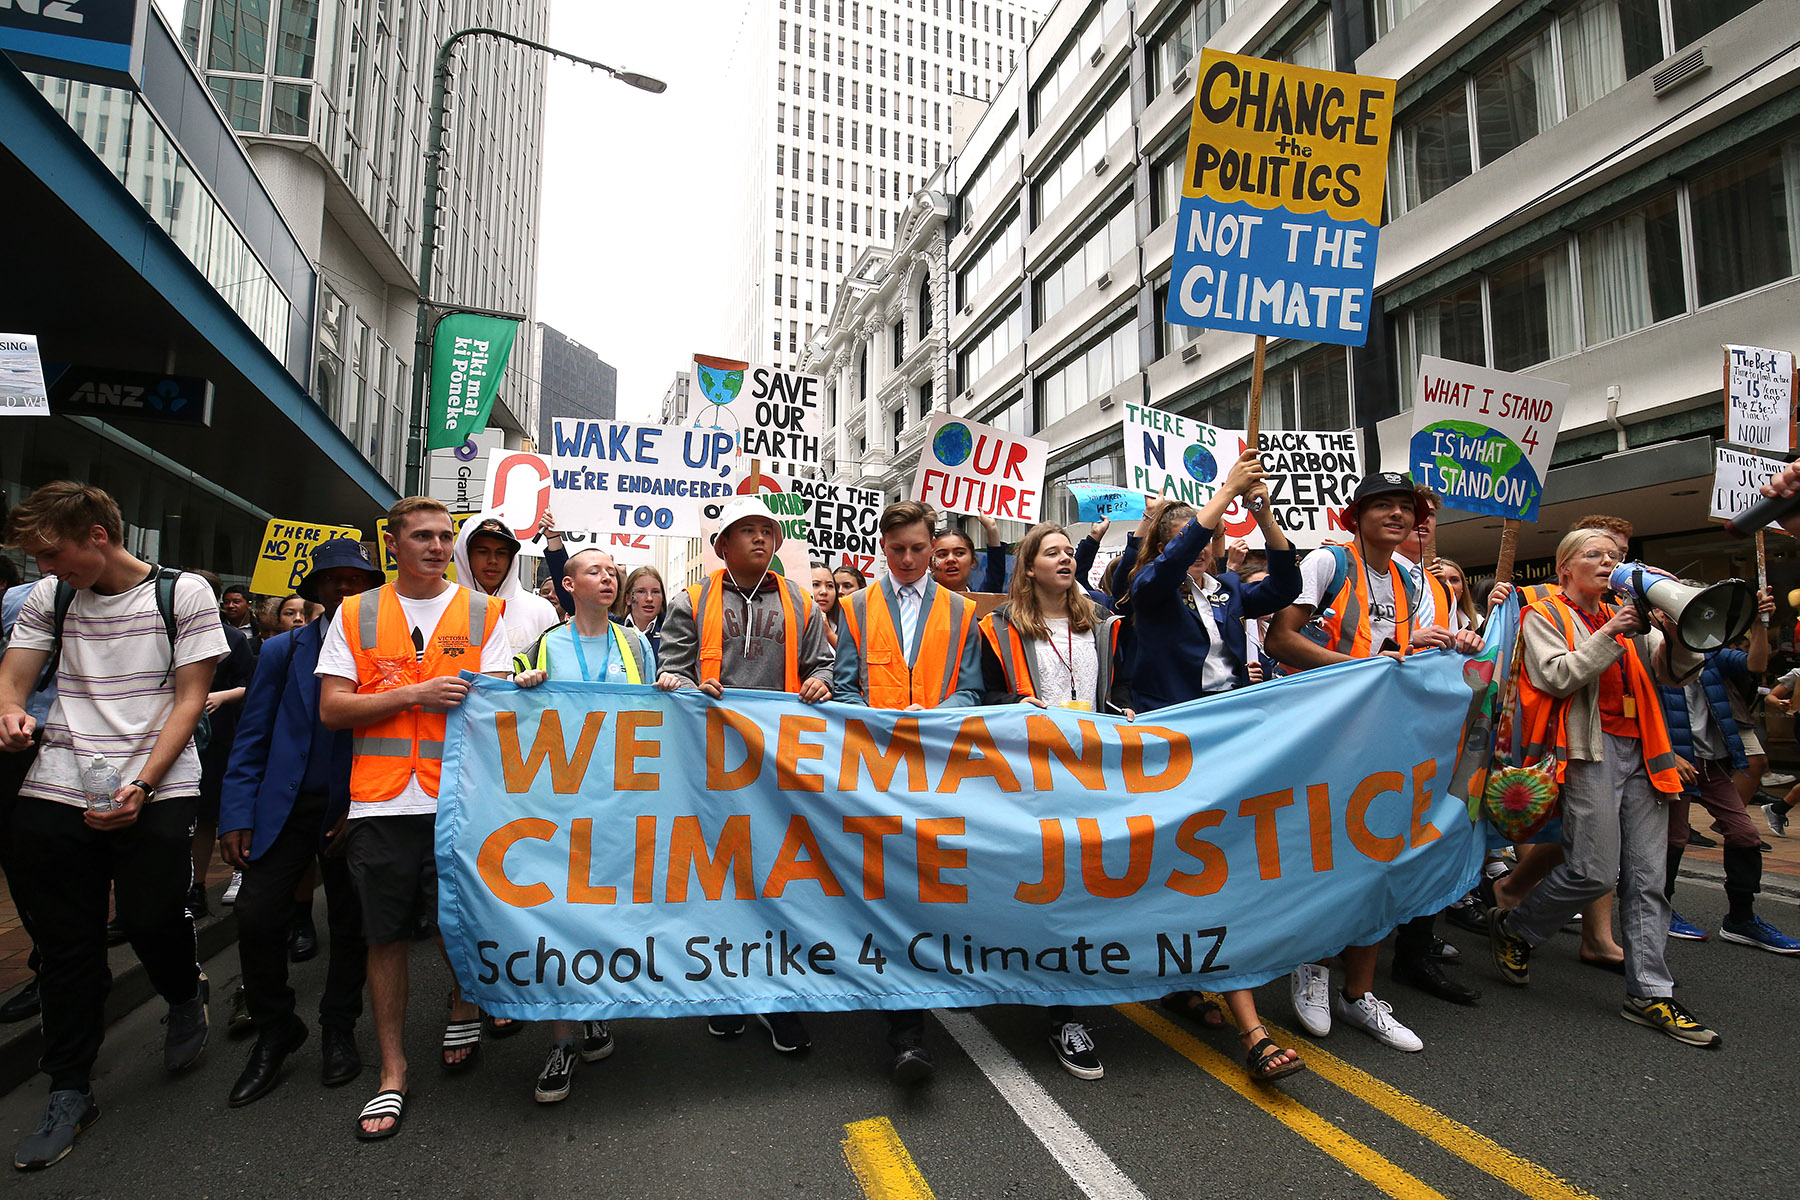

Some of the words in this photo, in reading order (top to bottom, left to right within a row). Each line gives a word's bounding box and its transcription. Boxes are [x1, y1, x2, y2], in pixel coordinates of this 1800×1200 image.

[1200, 61, 1385, 146] CHANGE
[1275, 136, 1312, 158] the
[1193, 143, 1361, 208] POLITICS
[1186, 209, 1263, 259] NOT
[1281, 222, 1367, 269] THE
[1179, 264, 1365, 332] CLIMATE
[453, 336, 473, 356] ki
[470, 338, 490, 377] Piki
[1731, 349, 1754, 367] The
[1755, 352, 1777, 374] Best
[68, 381, 145, 408] ANZ
[463, 380, 482, 416] mai
[752, 368, 818, 407] SAVE
[1424, 375, 1475, 408] WHAT
[1479, 388, 1494, 415] I
[1498, 392, 1553, 423] STAND
[1747, 379, 1760, 399] 15
[755, 401, 805, 432] OUR
[1126, 403, 1186, 438] THERE
[1195, 423, 1217, 447] IS
[554, 420, 663, 466] WAKE
[682, 429, 735, 479] UP,
[743, 427, 819, 463] EARTH
[1257, 433, 1308, 453] BACK
[1315, 433, 1356, 452] THE
[1430, 431, 1456, 458] IS
[1459, 435, 1507, 464] WHAT
[1521, 425, 1539, 456] 4
[1738, 424, 1771, 446] NOW!
[1260, 452, 1356, 474] CARBON
[1738, 456, 1757, 469] not
[456, 466, 473, 503] Grant
[552, 465, 609, 491] WE'RE
[617, 473, 733, 498] ENDANGERED
[920, 468, 1036, 521] FUTURE
[1134, 465, 1216, 508] PLANET
[1264, 474, 1361, 506] ZERO
[1419, 462, 1434, 491] I
[1438, 465, 1493, 500] STAND
[846, 487, 880, 508] THE
[273, 524, 321, 541] THERE
[613, 503, 674, 530] TOO
[1274, 507, 1321, 531] ACT
[1327, 508, 1347, 532] N
[264, 540, 290, 555] NO
[610, 533, 650, 549] NZ
[807, 528, 877, 556] ARBON
[842, 552, 875, 578] NZ
[495, 709, 664, 795] WE
[706, 706, 1194, 795] DEMAND
[476, 814, 968, 908] CLIMATE
[1014, 758, 1443, 906] JUSTICE
[476, 936, 664, 987] School
[685, 929, 836, 982] Strike
[857, 932, 887, 975] 4
[907, 931, 1131, 977] Climate
[1156, 925, 1231, 979] NZ
